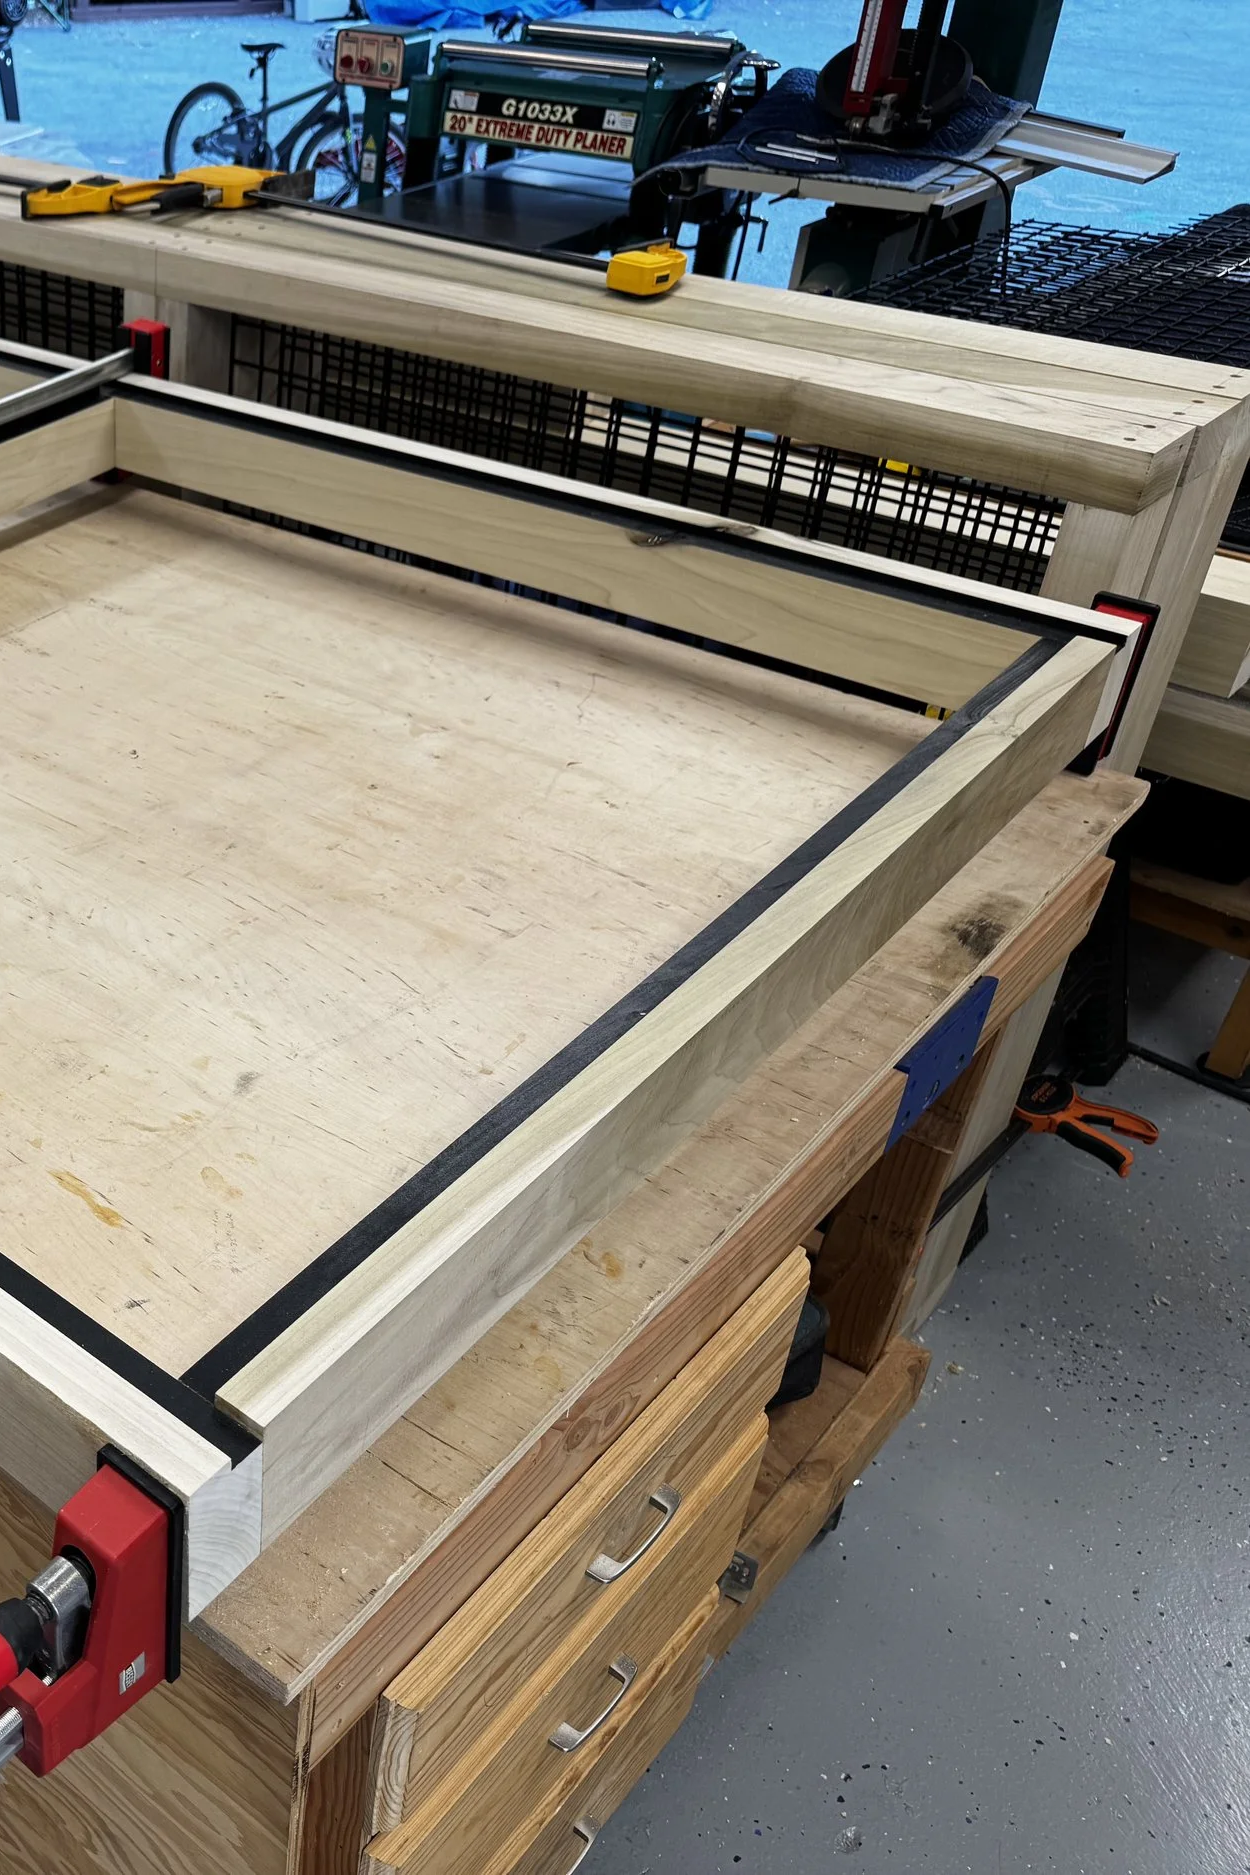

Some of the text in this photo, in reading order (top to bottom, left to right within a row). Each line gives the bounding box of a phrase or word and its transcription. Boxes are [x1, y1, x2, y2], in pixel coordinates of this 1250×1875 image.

[501, 98, 579, 124] G1033X
[474, 118, 533, 141] EXTREME
[535, 126, 574, 148] DUTY
[573, 131, 627, 155] PLANER
